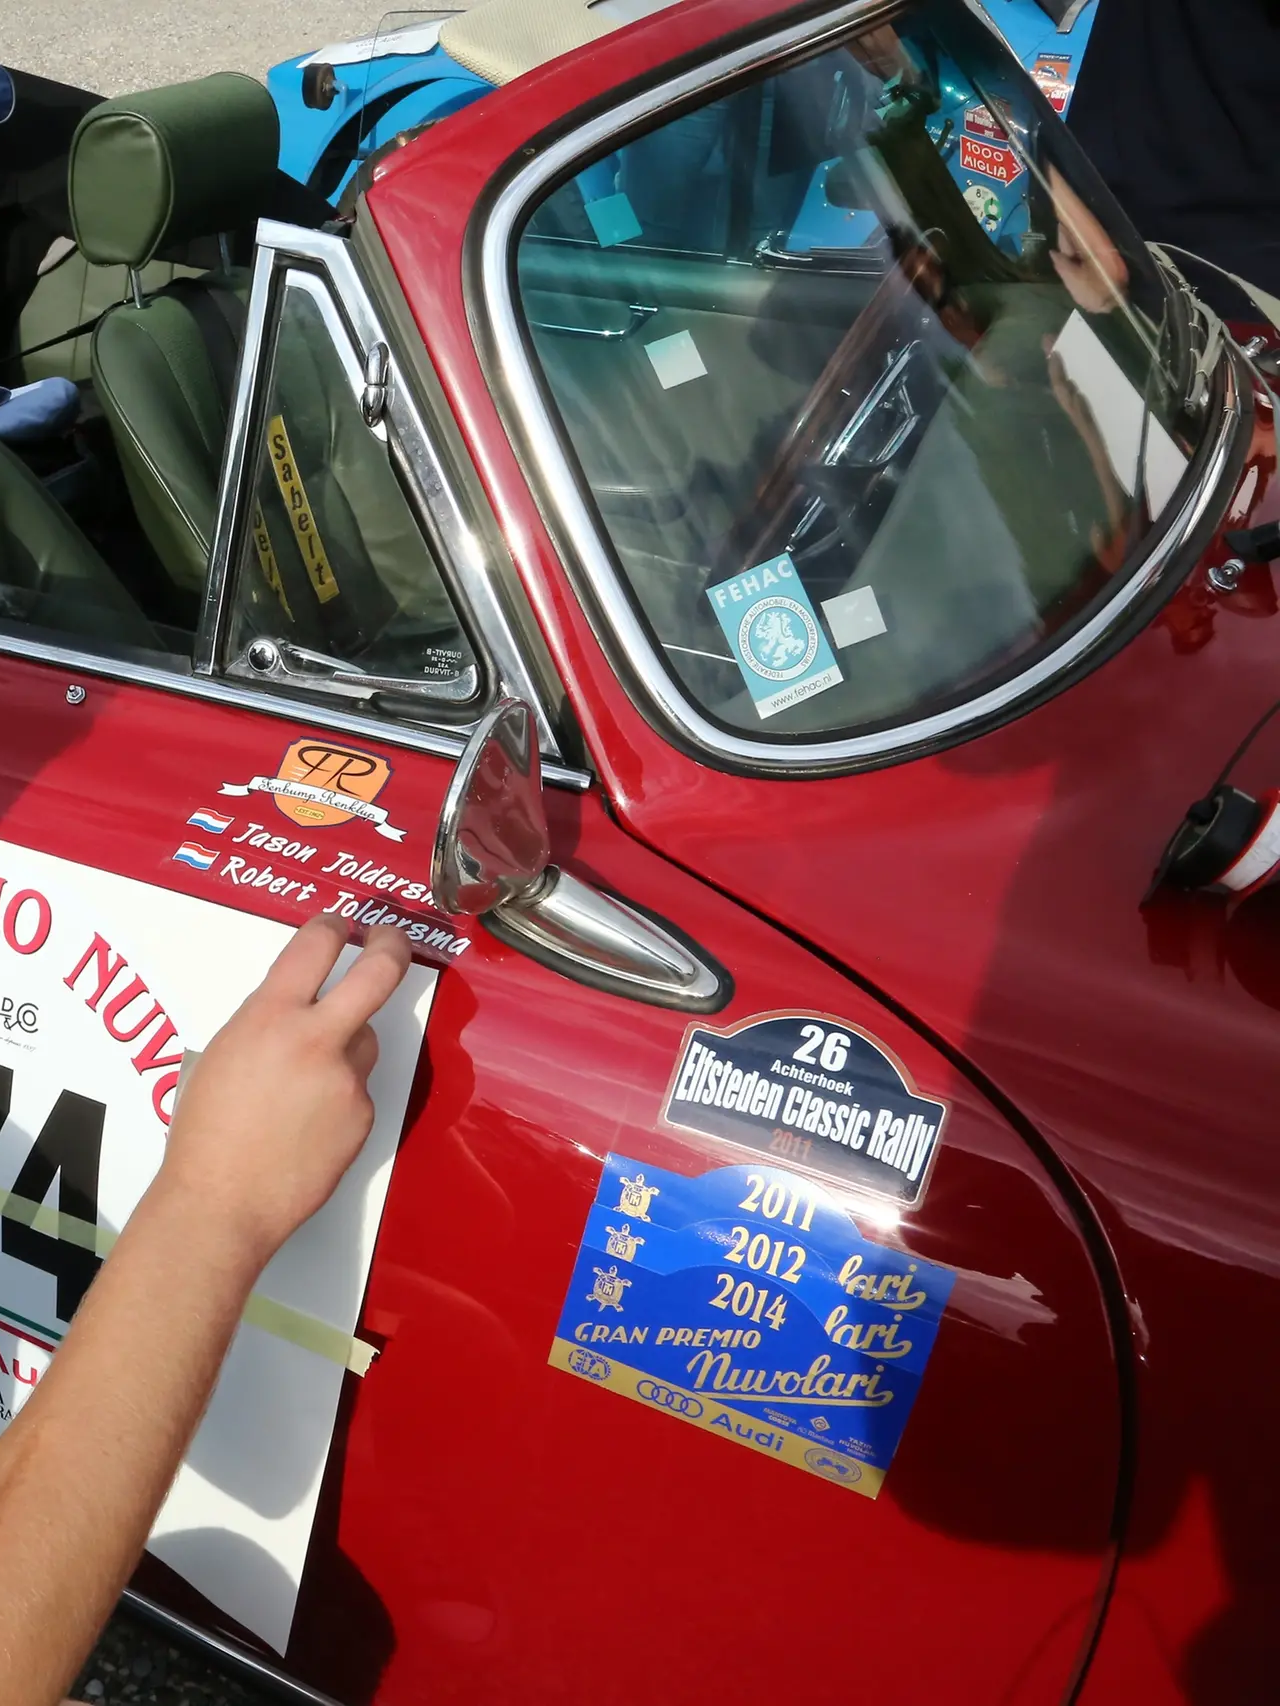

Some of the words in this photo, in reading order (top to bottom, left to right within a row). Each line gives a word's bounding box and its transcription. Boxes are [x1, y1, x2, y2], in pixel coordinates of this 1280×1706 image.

[964, 154, 1007, 178] MIGLIA
[966, 141, 1004, 162] 1000
[272, 434, 325, 585] Sabelt
[714, 560, 793, 609] FEHAC
[771, 674, 832, 708] www.fehac.nl
[232, 822, 318, 863] Jason
[220, 855, 318, 903] Robert
[792, 1024, 852, 1072] 26
[770, 1059, 855, 1097] Achterhoek
[675, 1040, 784, 1121] Elfsteden
[781, 1086, 872, 1150] Classic
[866, 1108, 936, 1182] Rally
[769, 1128, 813, 1160] 2011
[738, 1173, 817, 1232] 2011
[724, 1226, 807, 1284] 2012
[709, 1273, 788, 1331] 2014
[574, 1322, 649, 1344] GRAN
[655, 1327, 762, 1349] PREMIO
[686, 1349, 894, 1408] Nuvolari
[710, 1413, 785, 1452] Audi
